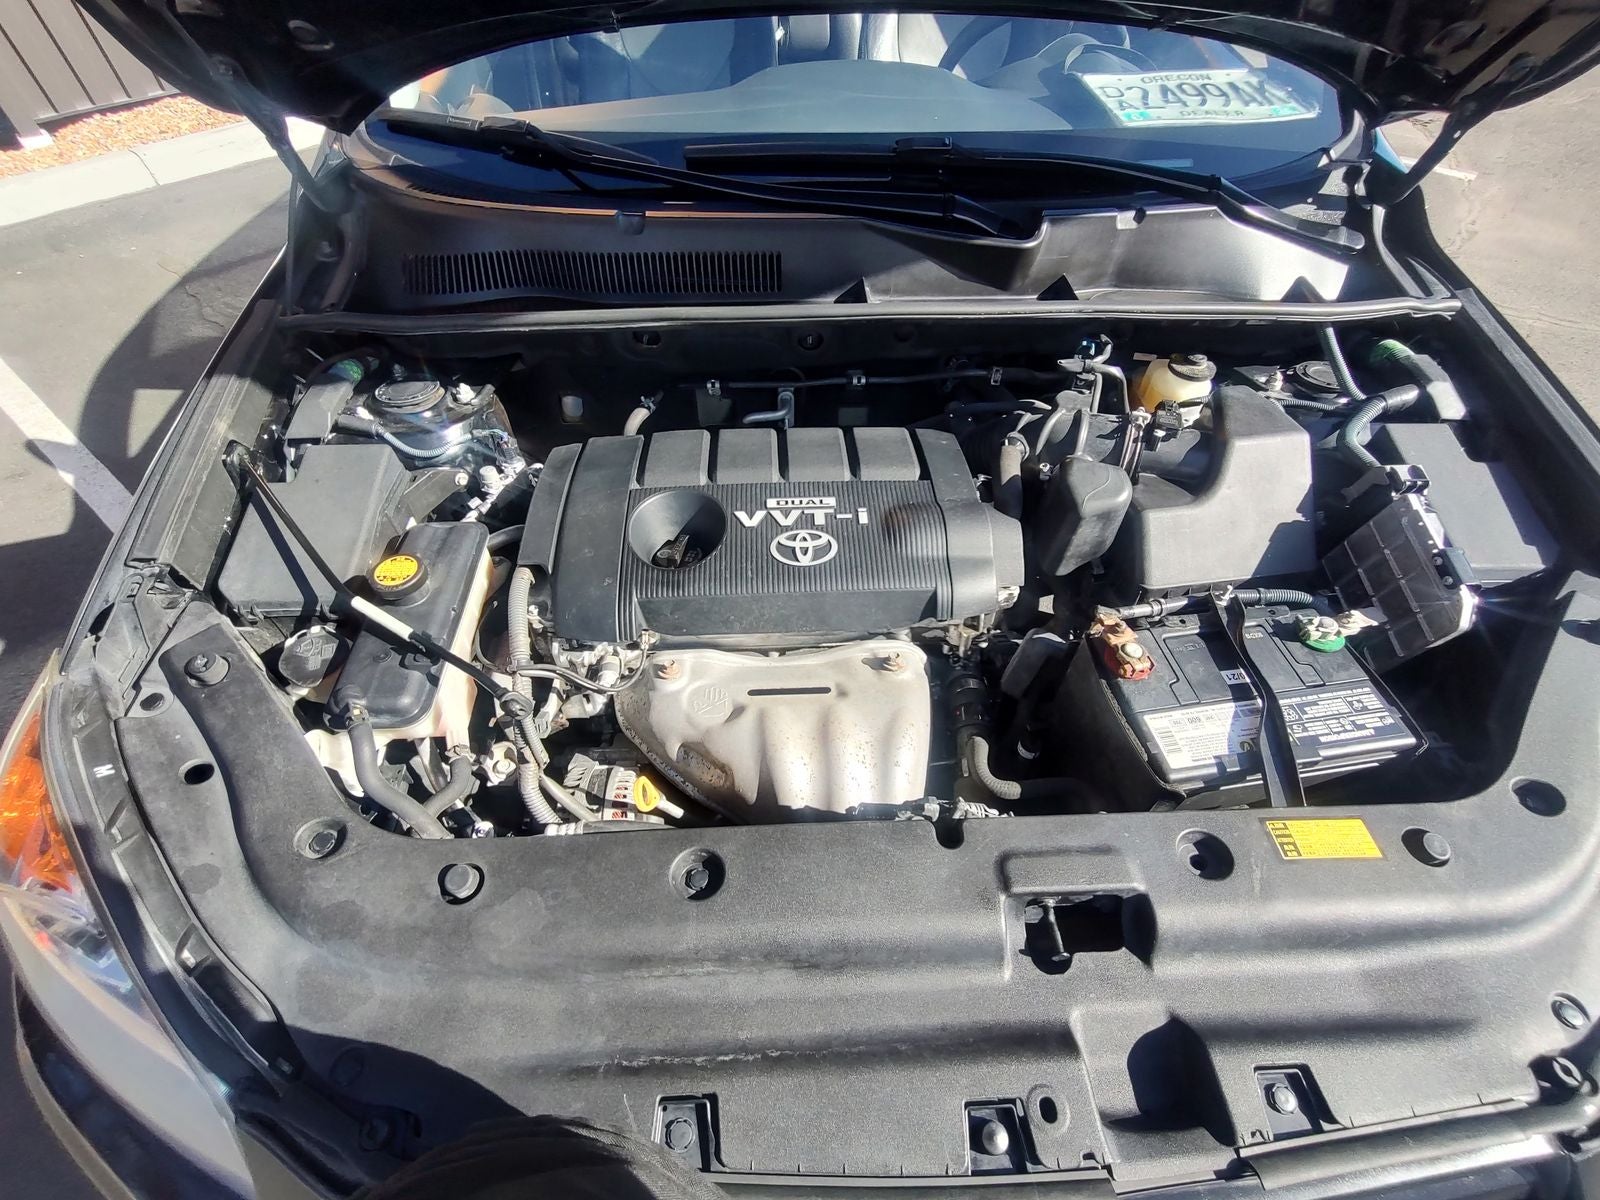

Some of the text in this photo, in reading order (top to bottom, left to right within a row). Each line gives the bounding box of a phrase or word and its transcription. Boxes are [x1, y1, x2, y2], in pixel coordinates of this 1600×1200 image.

[1140, 72, 1213, 84] OREGON
[1179, 110, 1245, 118] DEALER
[733, 507, 869, 528] VVT-i
